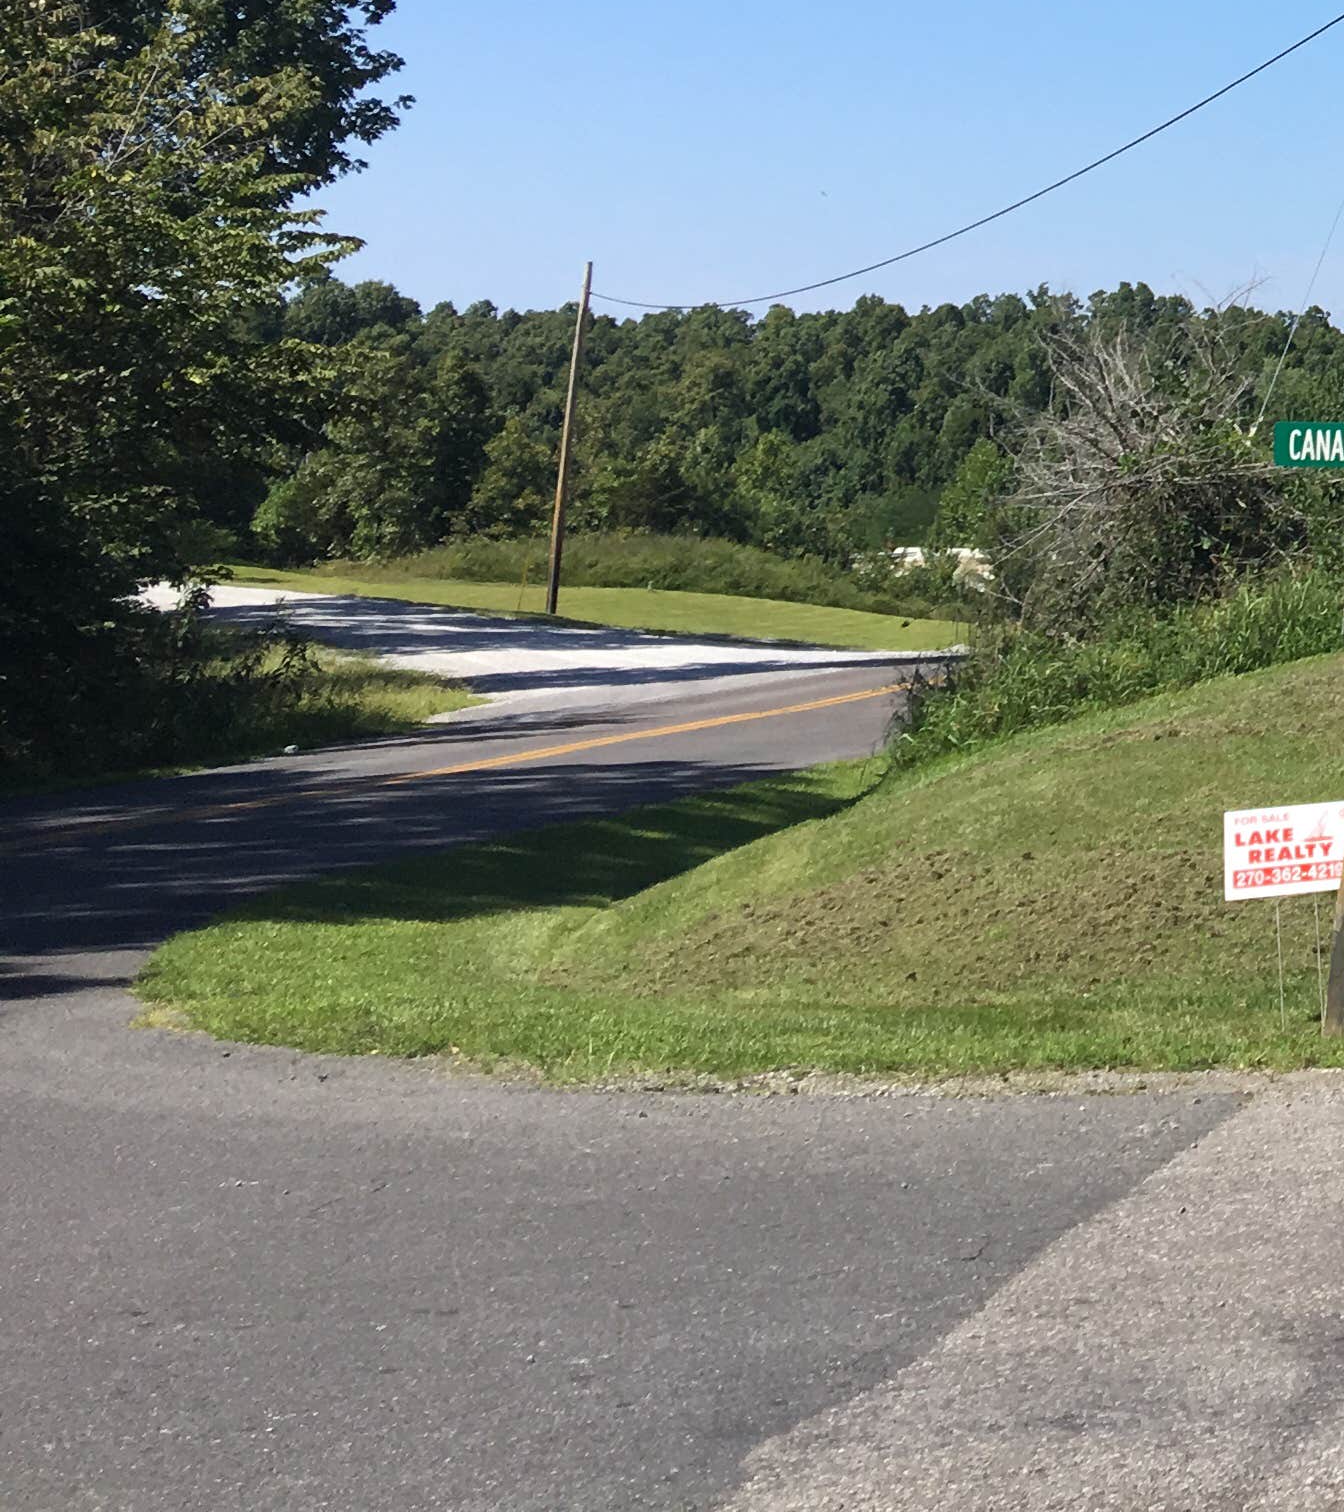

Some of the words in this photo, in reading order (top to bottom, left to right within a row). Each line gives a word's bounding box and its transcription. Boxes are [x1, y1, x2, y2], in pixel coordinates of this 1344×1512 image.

[1234, 816, 1257, 825] FOR
[1262, 812, 1289, 823] SALE
[1235, 827, 1294, 847] LAKE
[1248, 842, 1333, 864] REALTY
